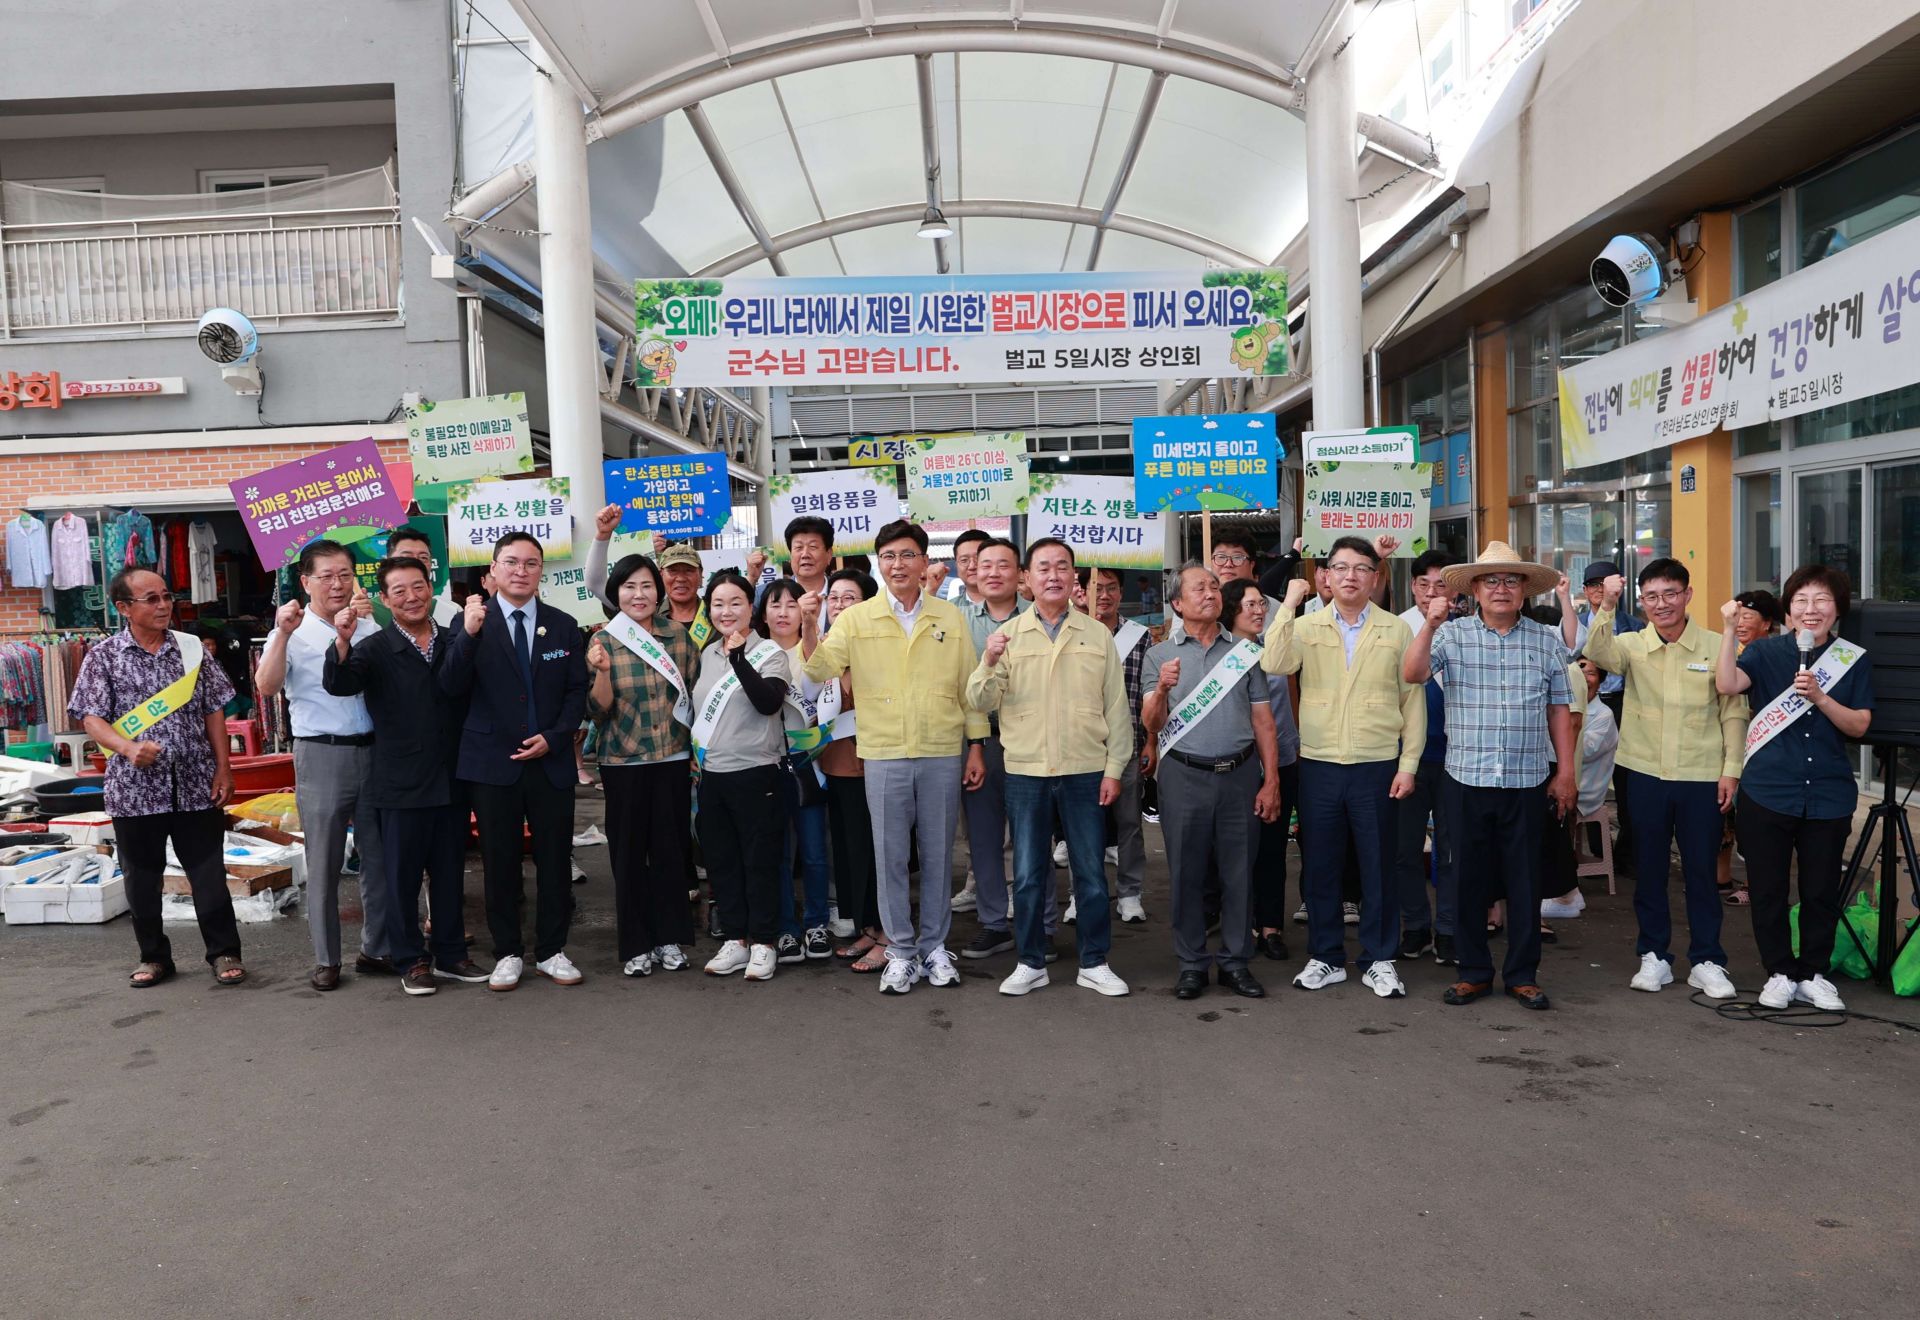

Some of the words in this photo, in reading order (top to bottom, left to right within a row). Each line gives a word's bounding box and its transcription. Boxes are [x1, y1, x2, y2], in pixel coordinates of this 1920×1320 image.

[664, 299, 718, 336] 오메!
[724, 297, 859, 336] 우리나라에서
[866, 295, 910, 334] 제일
[918, 294, 986, 333] 시원한
[991, 292, 1126, 332] 벌교시장으로
[1133, 291, 1176, 328] 피서
[1183, 288, 1259, 328] 오세요.
[727, 348, 806, 376] 군수님
[816, 346, 960, 374] 고맙습니다.
[1005, 349, 1046, 370] 벌교
[1054, 347, 1131, 369] 5일시장
[1139, 345, 1201, 367] 상인회
[1585, 382, 1622, 435] 전남에
[1628, 366, 1672, 414] 의대를
[1681, 333, 1757, 407] 설립하여
[1768, 291, 1864, 380] 건강하게
[85, 382, 154, 393] 857-1043
[1778, 371, 1843, 410] 벌교5일시장
[425, 424, 468, 441] 불필요한
[469, 419, 513, 437] 이메일과
[450, 440, 472, 456] 사진
[473, 435, 516, 454] 삭제하기
[1152, 441, 1211, 459] 미세먼지
[1214, 440, 1258, 457] 줄이고
[1316, 444, 1359, 457] 점심시간
[1361, 442, 1403, 454] 소등하기
[924, 454, 956, 471] 여름엔
[985, 450, 1009, 465] 이상,
[1144, 462, 1174, 478] 푸른
[1177, 461, 1206, 477] 하늘
[1210, 458, 1268, 476] 만들어요
[625, 462, 706, 481] 탄소중립포인트
[922, 472, 953, 488] 겨울엔
[982, 467, 1014, 483] 이하로
[246, 494, 290, 520] 가까운
[290, 480, 332, 505] 거리는
[334, 463, 383, 490] 걸어서,
[643, 479, 691, 494] 가입하고
[948, 487, 991, 505] 유지하기
[258, 515, 286, 536] 우리
[288, 482, 386, 526] 친환경운전해요
[460, 502, 509, 521] 저탄소
[514, 498, 565, 518] 생활을
[632, 495, 666, 510] 에너지
[669, 492, 705, 506] 절약에
[791, 489, 878, 513] 일회용품을
[1041, 497, 1097, 516] 저탄소
[1319, 491, 1342, 508] 샤워
[1344, 491, 1377, 508] 시간은
[1380, 491, 1416, 509] 줄이고,
[646, 508, 693, 525] 동참하기
[831, 515, 871, 533] 시다
[1321, 512, 1354, 529] 빨래는
[1356, 512, 1389, 529] 모아서
[1391, 511, 1413, 529] 하기
[1050, 524, 1143, 546] 실천합시다
